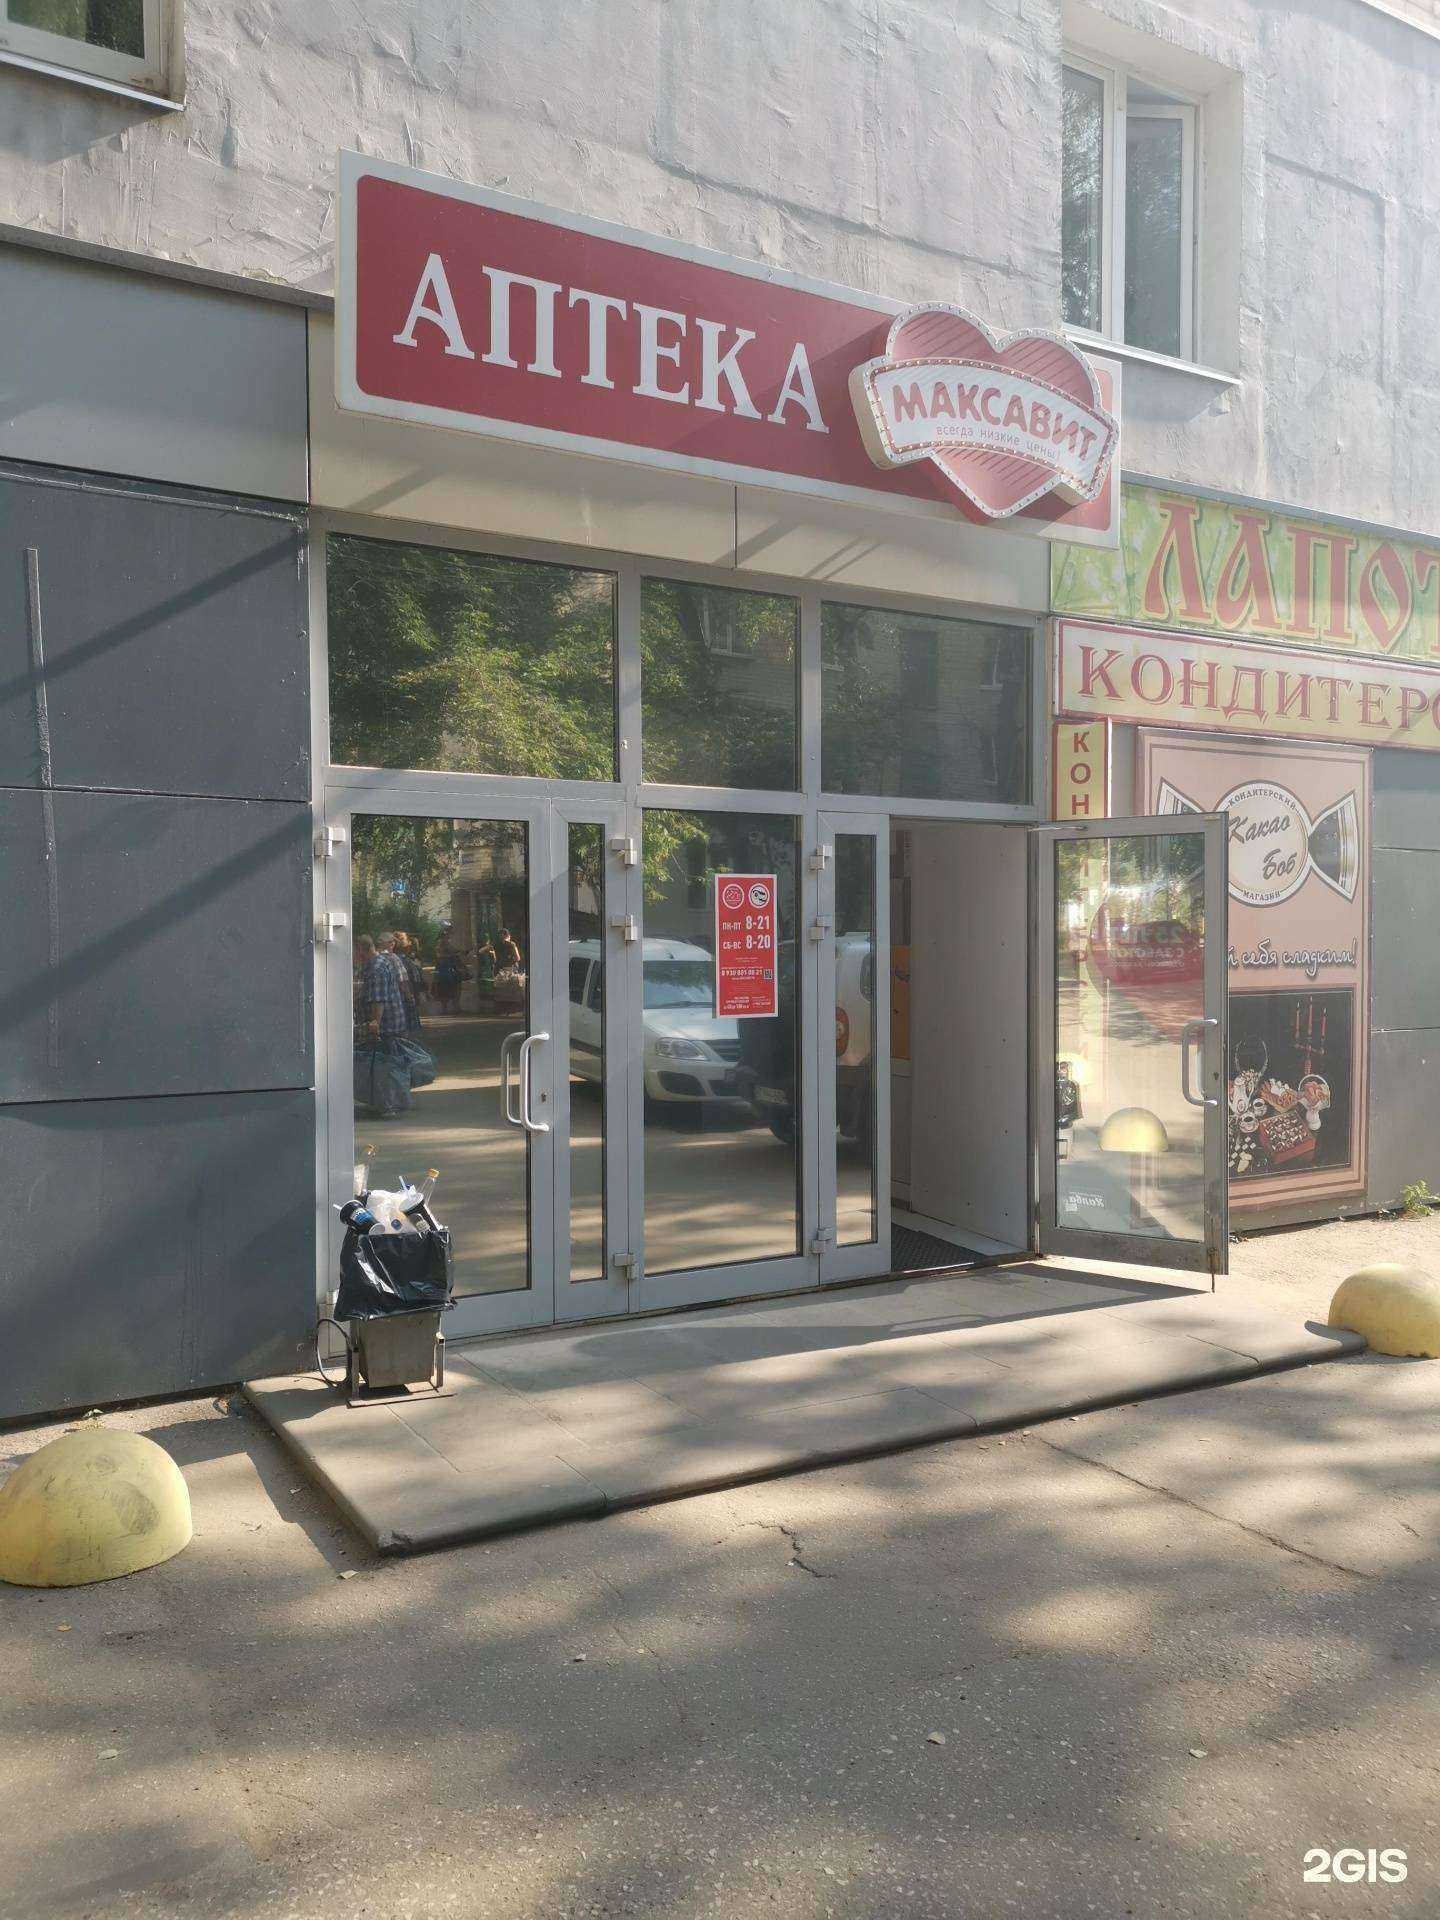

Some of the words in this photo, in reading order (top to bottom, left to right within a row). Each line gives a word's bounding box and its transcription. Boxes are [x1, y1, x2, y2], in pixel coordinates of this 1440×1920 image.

[391, 252, 830, 434] АПТЕКА
[892, 380, 1098, 461] МАКСАВИТ
[936, 425, 974, 437] всегда
[979, 430, 1021, 447] низкие
[1228, 814, 1291, 845] Какао
[1262, 848, 1298, 880] Боб
[1242, 889, 1282, 901] МАГАЗИН
[745, 915, 770, 930] 8-21
[745, 934, 771, 950] 8-20
[1241, 937, 1278, 965] себя
